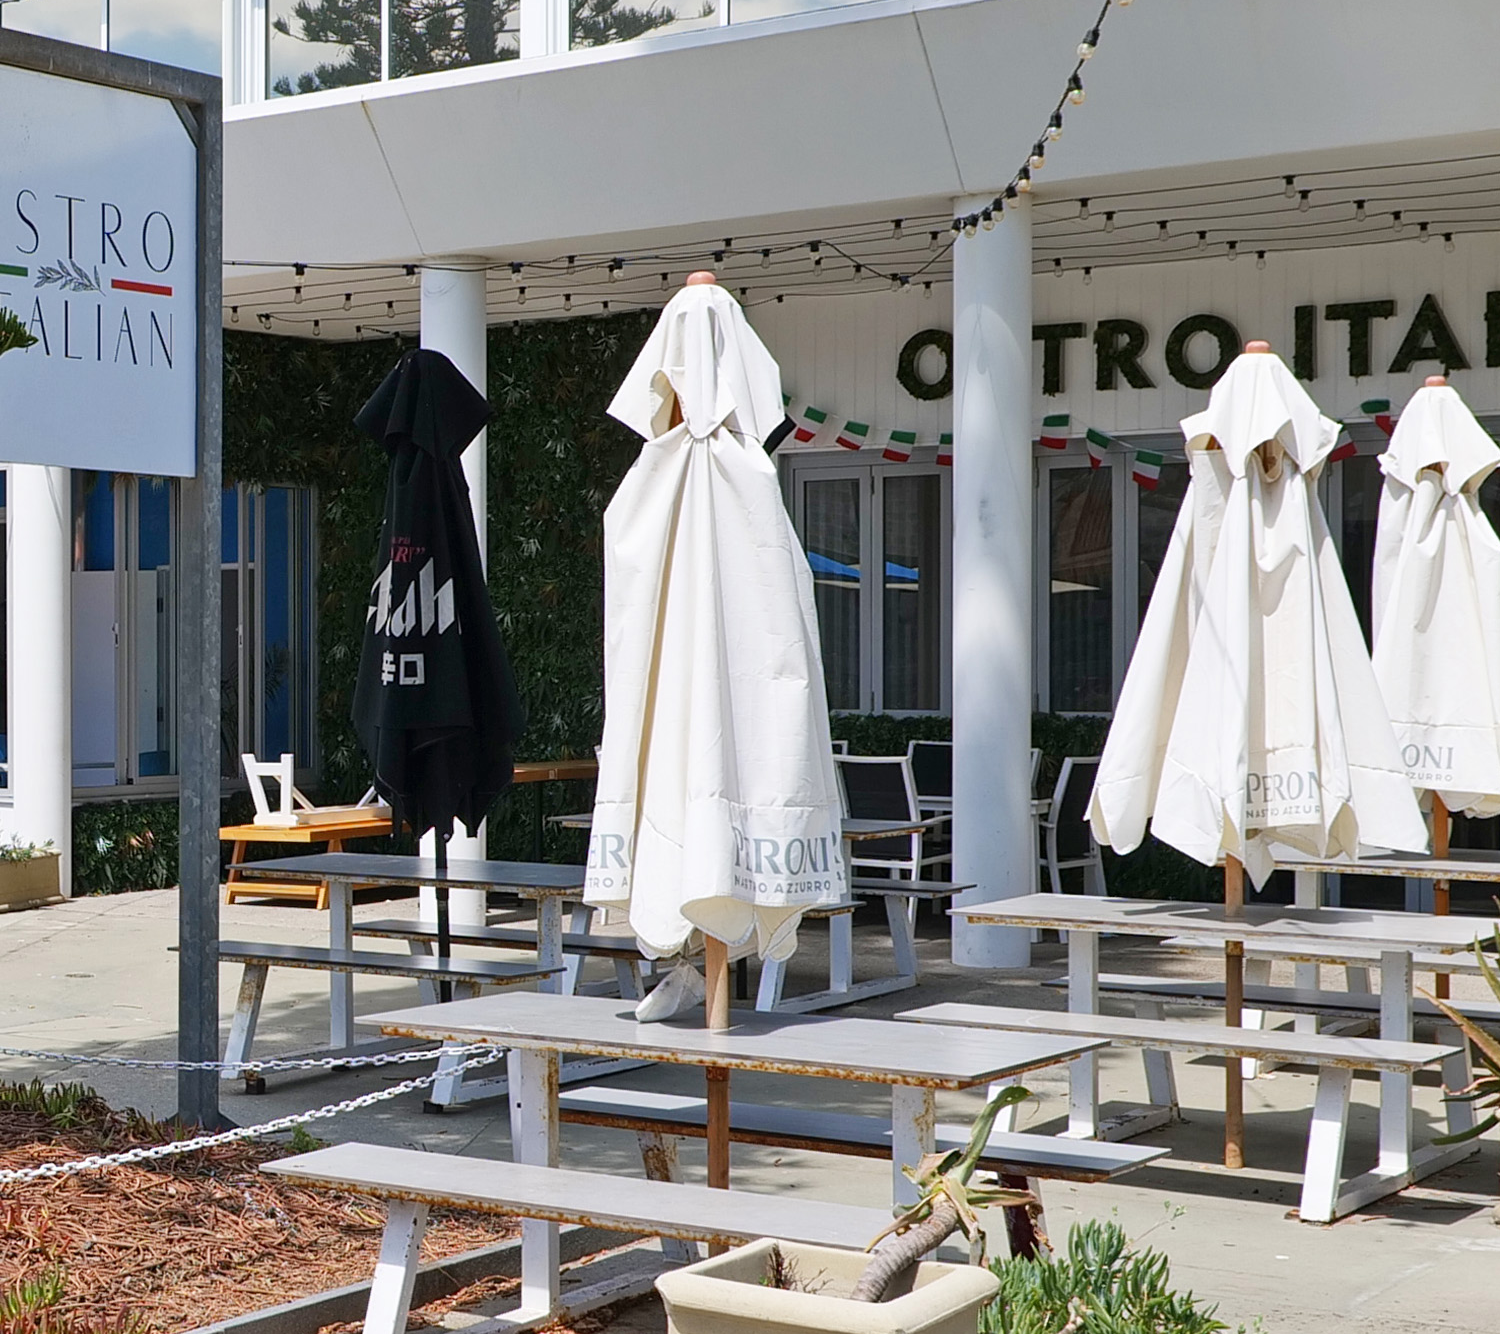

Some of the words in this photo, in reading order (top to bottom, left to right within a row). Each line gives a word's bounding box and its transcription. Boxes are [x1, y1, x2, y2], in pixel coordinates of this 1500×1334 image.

[897, 313, 1242, 401] OTRO
[1246, 771, 1320, 804] PERON
[774, 880, 831, 894] AZZURRO
